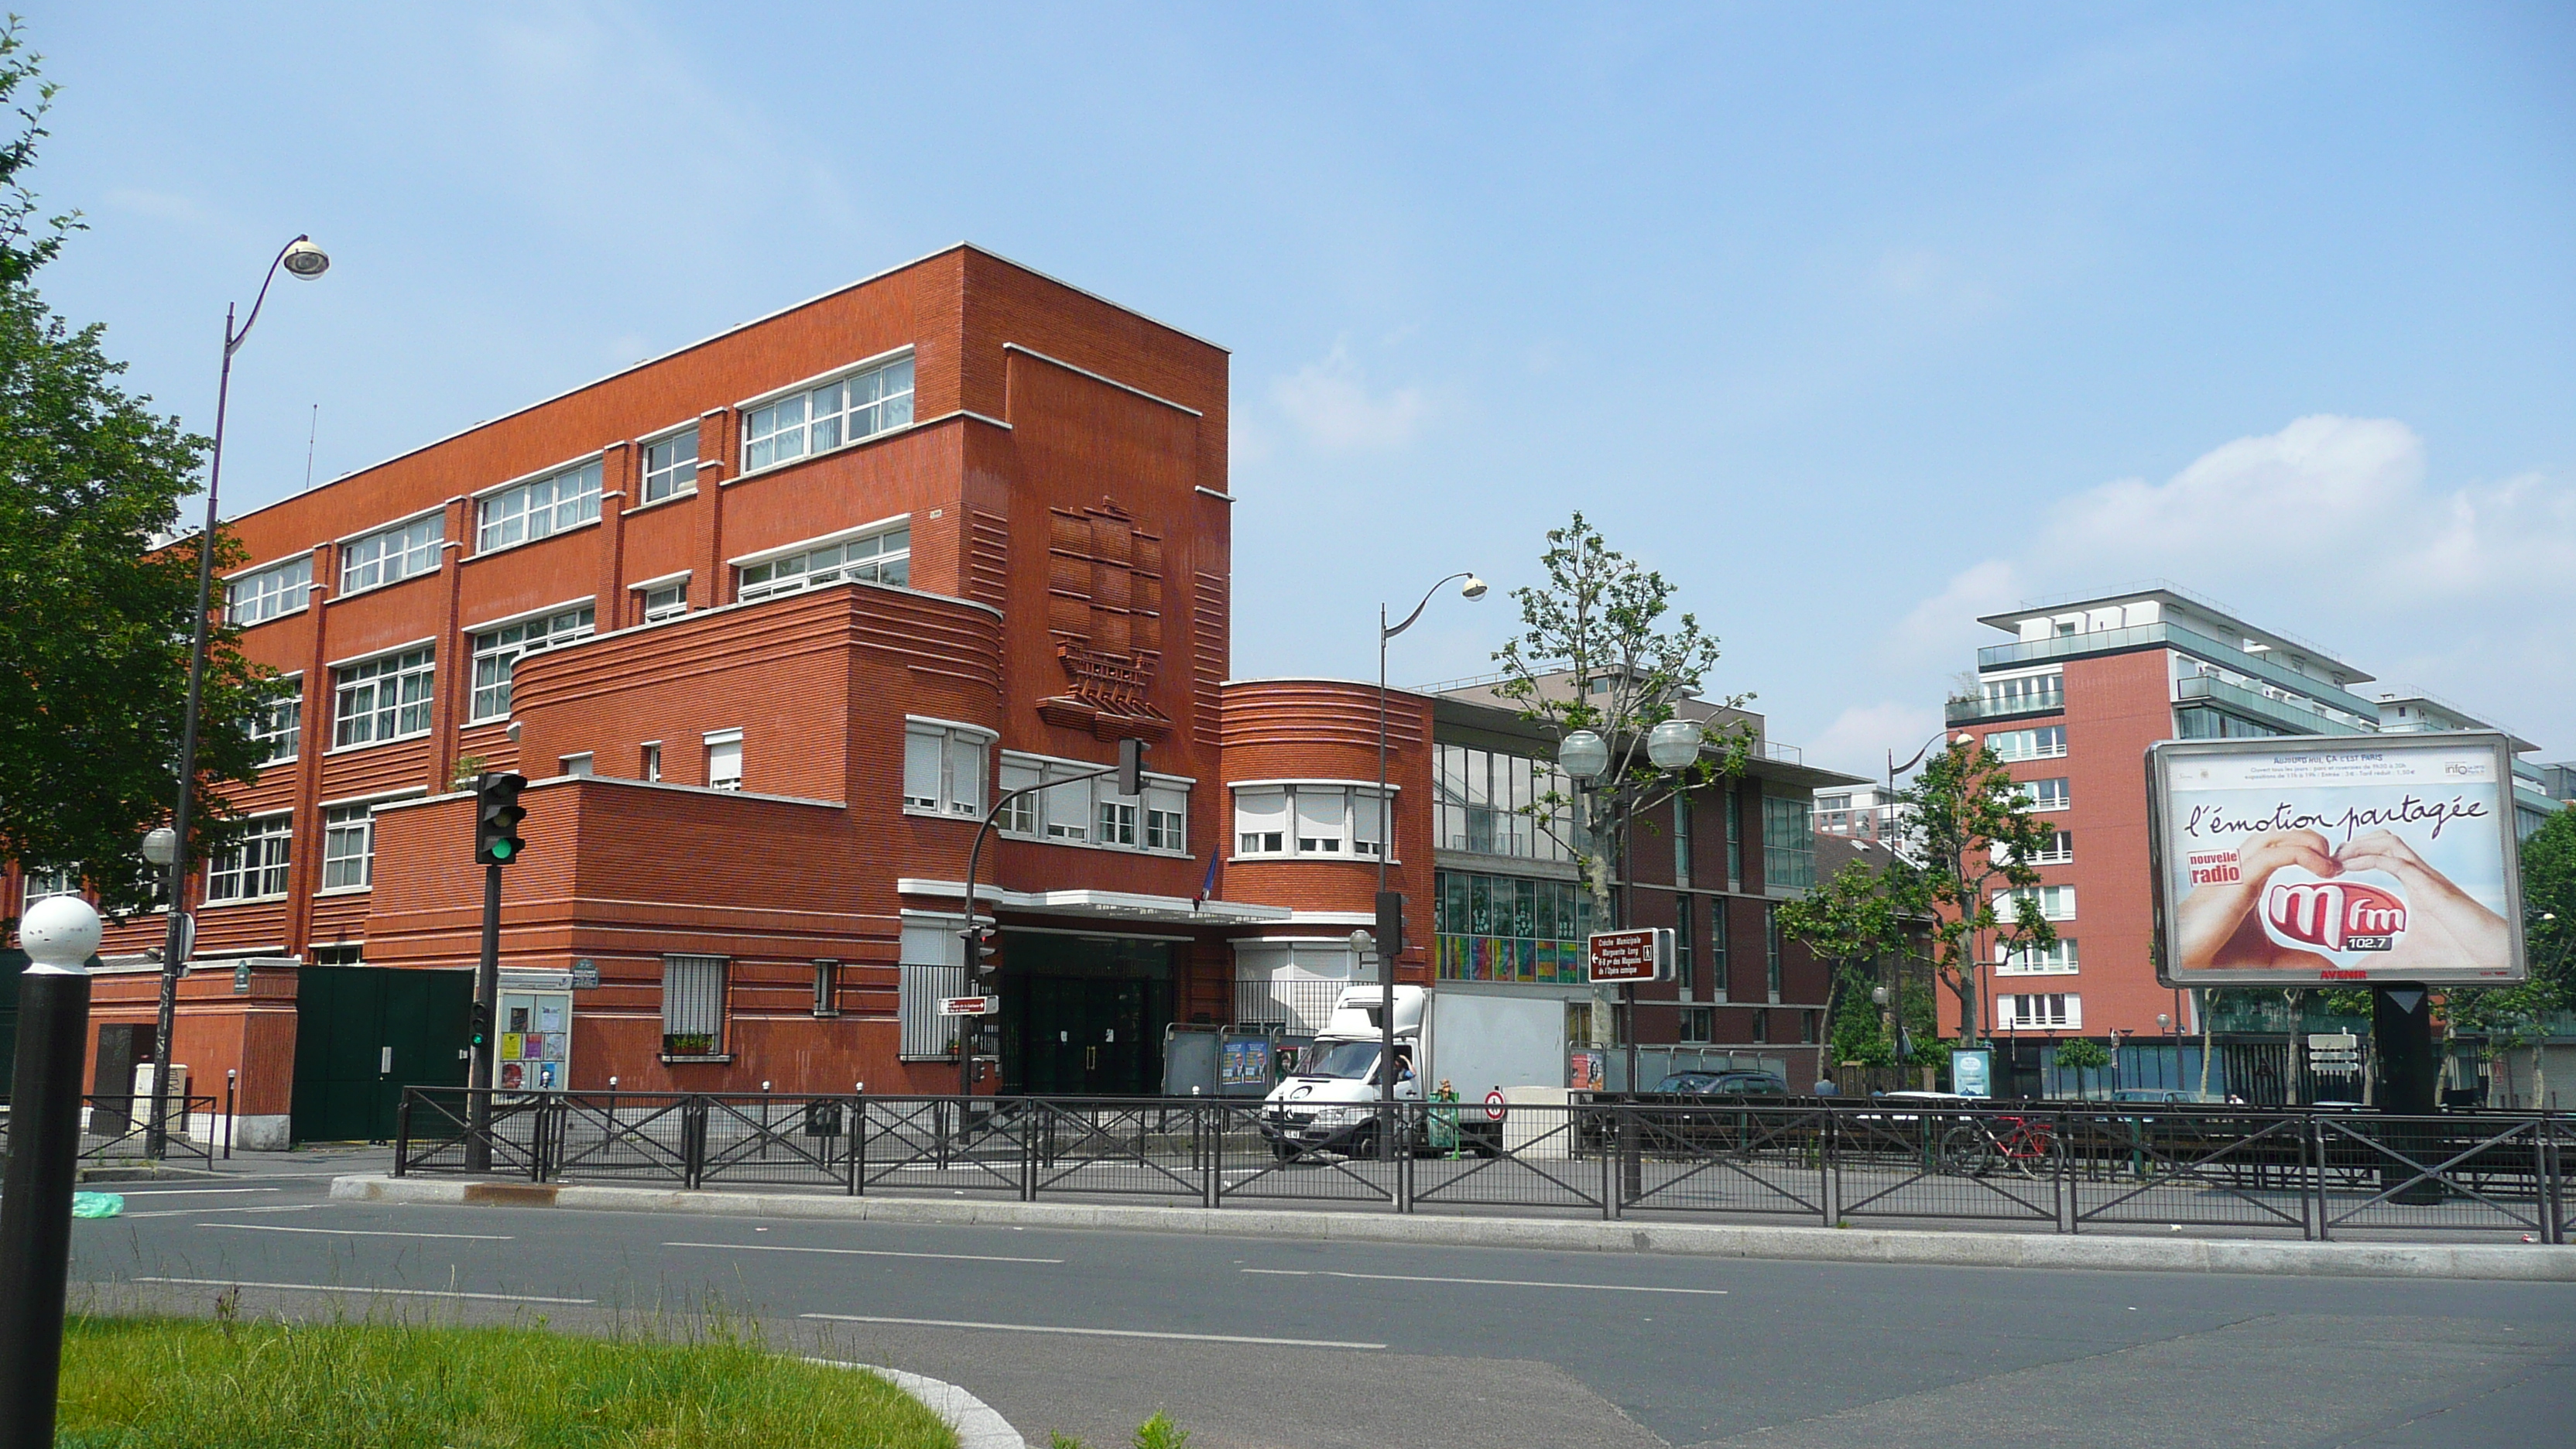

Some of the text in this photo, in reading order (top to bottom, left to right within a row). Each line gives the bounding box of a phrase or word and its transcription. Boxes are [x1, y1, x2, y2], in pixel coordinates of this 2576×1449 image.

[2326, 755, 2338, 764] ÇA
[2361, 753, 2383, 762] PARIS
[2184, 793, 2489, 841] l'émotion partagée
[2189, 851, 2238, 865] nouvelle
[2191, 864, 2240, 884] radio
[1616, 936, 1641, 946] Municipale
[2348, 937, 2386, 949] 102.7
[1627, 947, 1639, 956] Long
[2321, 970, 2367, 979] AVENIR
